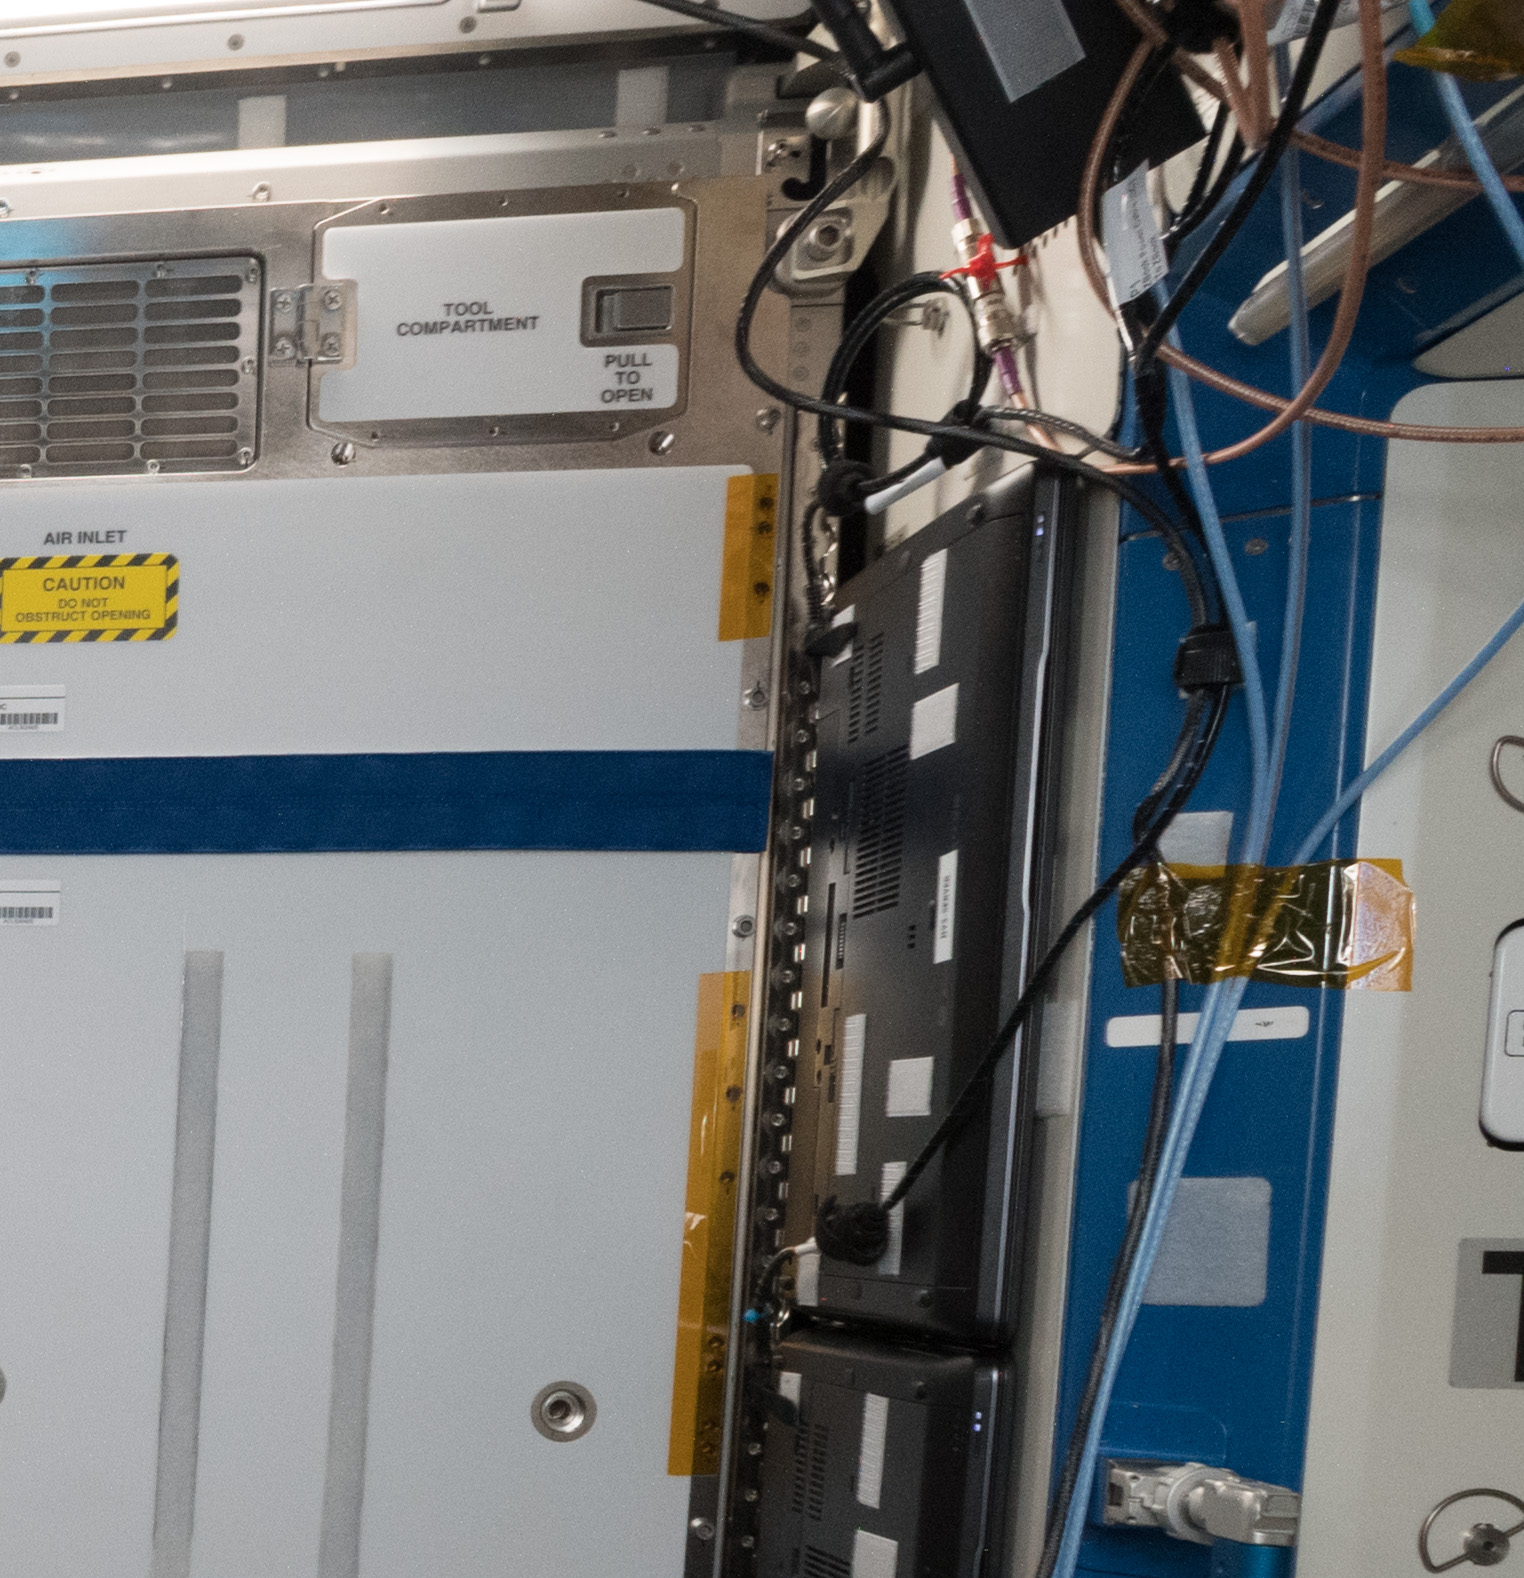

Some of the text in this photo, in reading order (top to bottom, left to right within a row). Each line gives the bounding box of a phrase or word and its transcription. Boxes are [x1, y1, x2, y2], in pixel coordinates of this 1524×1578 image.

[444, 301, 494, 317] TOOL
[397, 316, 540, 337] COMPARTMENT
[604, 353, 652, 368] PULL
[615, 371, 641, 385] TO
[600, 388, 653, 404] OPEN
[43, 530, 127, 545] AIR INLET
[43, 576, 125, 592] CAUTION
[58, 597, 109, 609] DO NOT
[15, 609, 150, 623] OBSTRUCT OPENING
